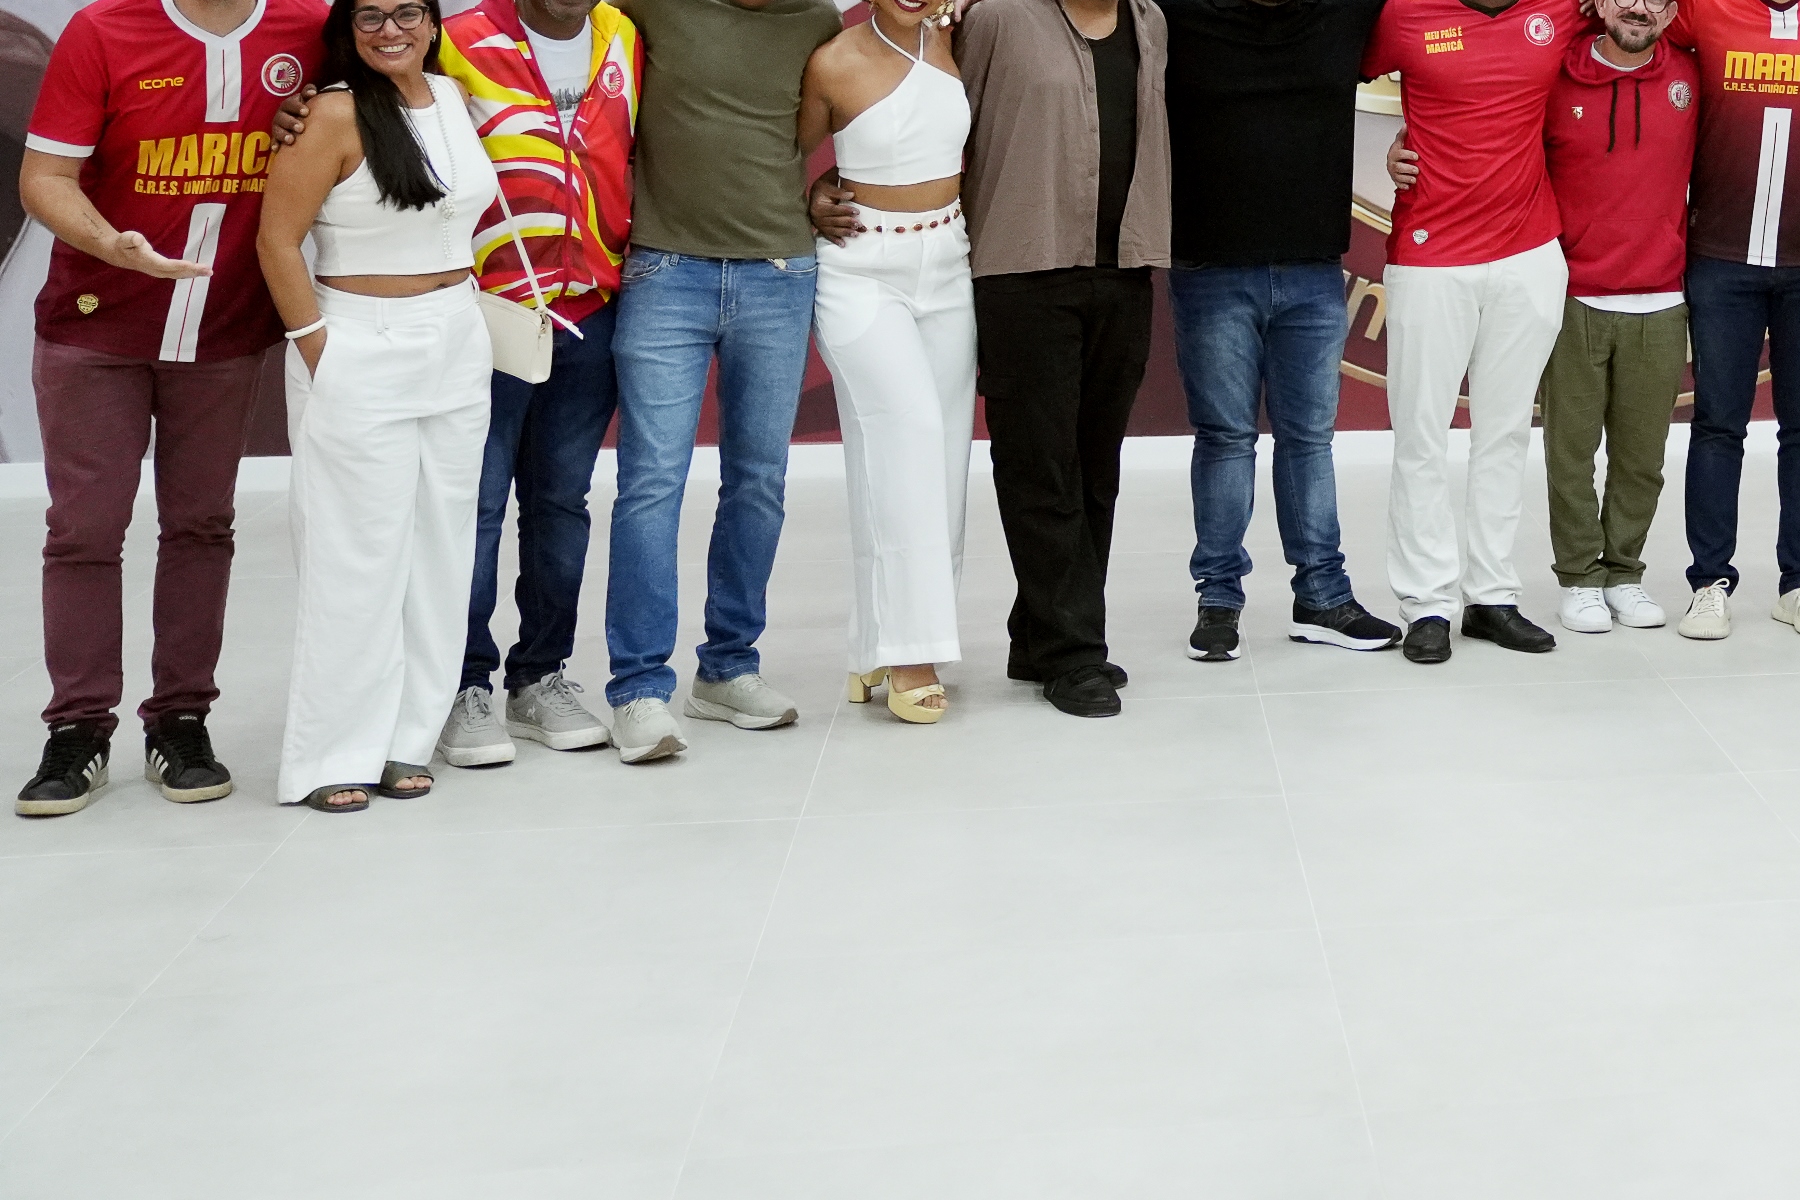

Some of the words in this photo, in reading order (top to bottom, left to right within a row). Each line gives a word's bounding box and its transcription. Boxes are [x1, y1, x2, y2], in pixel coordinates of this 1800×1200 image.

[1424, 31, 1440, 40] MEU
[1425, 39, 1464, 54] MARICÁ
[1758, 83, 1786, 94] UNIÃO
[1786, 85, 1799, 95] DE
[137, 131, 276, 177] MARIC
[135, 179, 180, 195] G.R.E.S.
[183, 178, 220, 195] UNIÃO
[222, 178, 239, 193] DE
